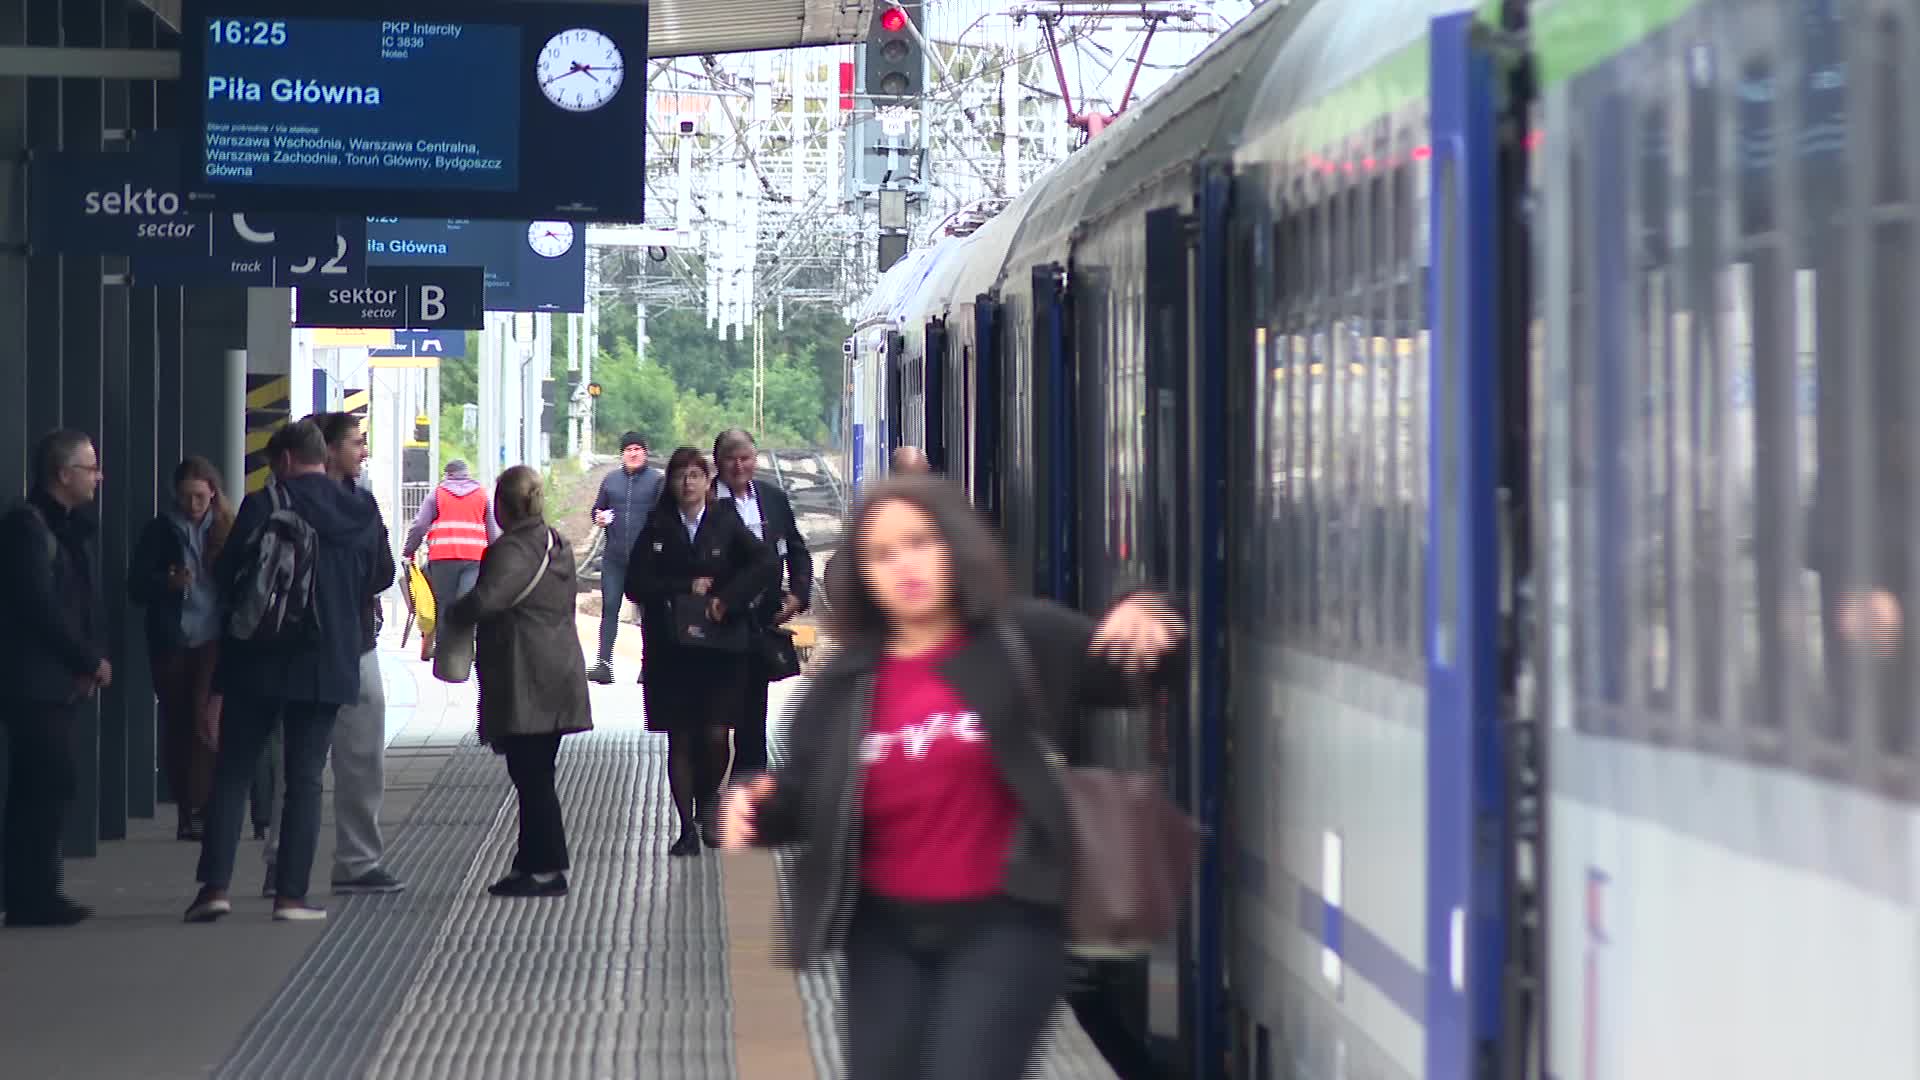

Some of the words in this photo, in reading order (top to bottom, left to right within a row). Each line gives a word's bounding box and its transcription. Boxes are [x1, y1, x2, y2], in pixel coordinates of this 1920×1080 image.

[209, 20, 287, 45] 16:25
[382, 21, 410, 34] PKP
[413, 23, 463, 39] Intercity
[382, 36, 394, 47] IC
[397, 36, 424, 48] 3836
[208, 76, 261, 101] Piła
[271, 79, 380, 105] Główna
[206, 134, 270, 148] Warszawa
[273, 135, 345, 152] Wschodnia,
[349, 137, 412, 151] Warszawa
[416, 139, 480, 155] Centralna,
[206, 148, 270, 163] Warszawa
[273, 150, 342, 166] Zachodnia,
[345, 152, 380, 166] Toruń
[435, 155, 502, 171] Bydgoszcz
[206, 163, 254, 177] Główna
[84, 183, 189, 215] sekto
[137, 220, 195, 238] sector
[366, 239, 386, 253] iła
[389, 238, 447, 254] Główna
[231, 261, 262, 273] track
[328, 286, 397, 304] sektor
[420, 285, 446, 321] B
[361, 307, 397, 318] sector
